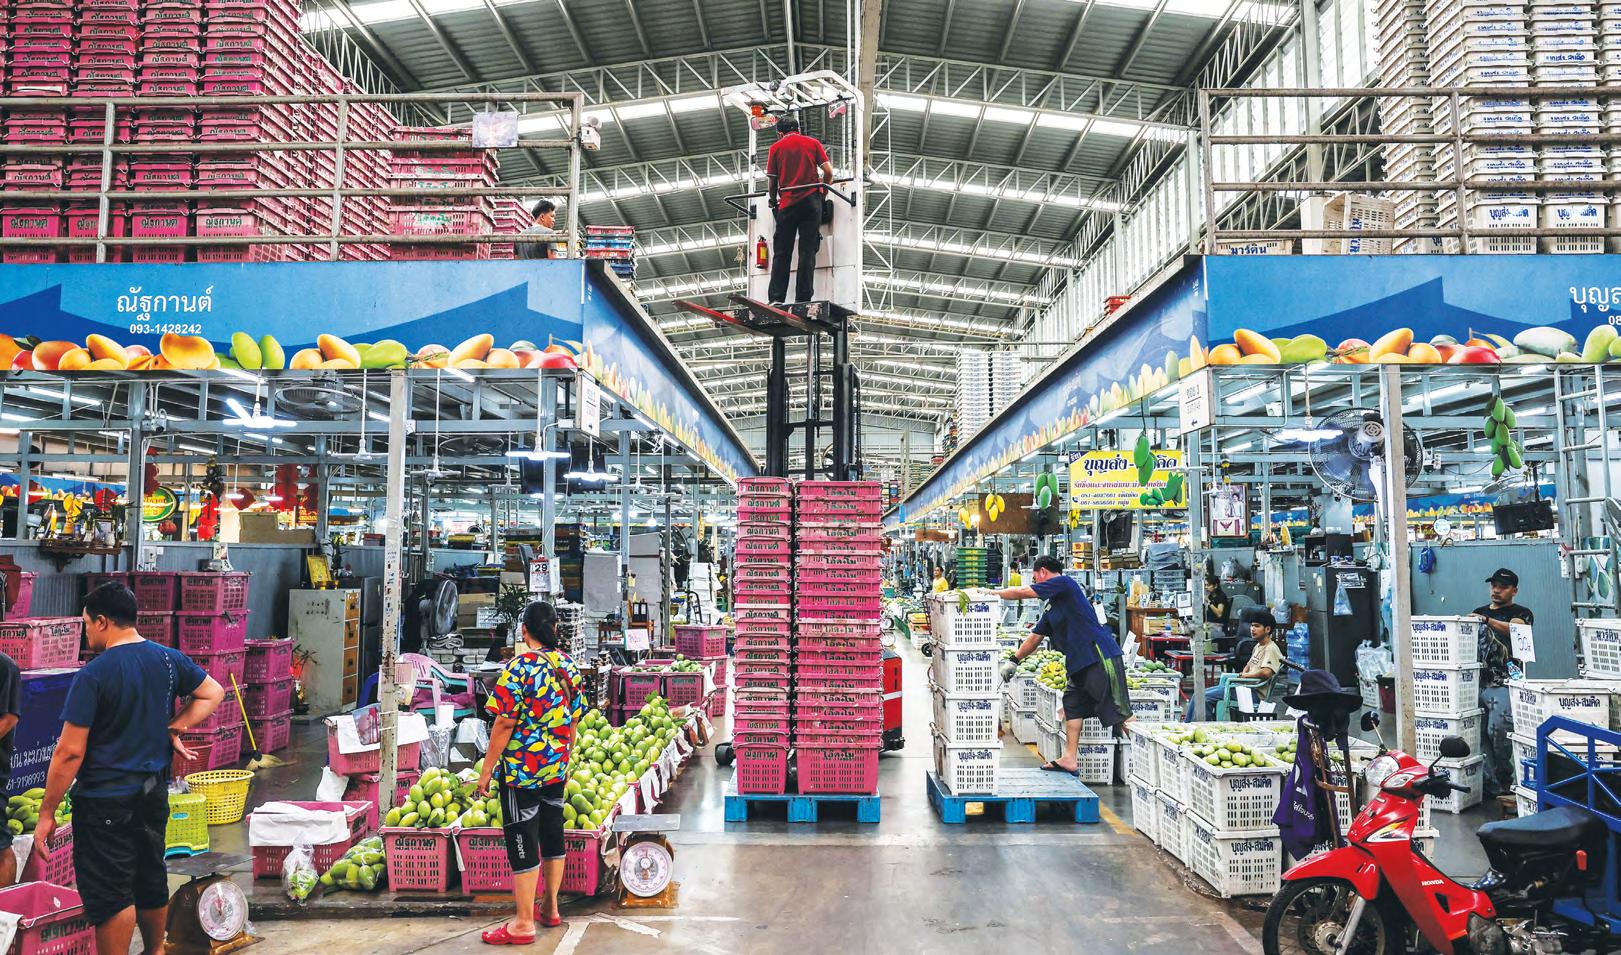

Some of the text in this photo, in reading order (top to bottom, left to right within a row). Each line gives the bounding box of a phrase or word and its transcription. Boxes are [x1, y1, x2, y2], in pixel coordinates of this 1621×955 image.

[117, 285, 214, 321] ณัฐกานต์
[129, 324, 202, 334] 093-1428242
[1421, 879, 1444, 887] HONDA
